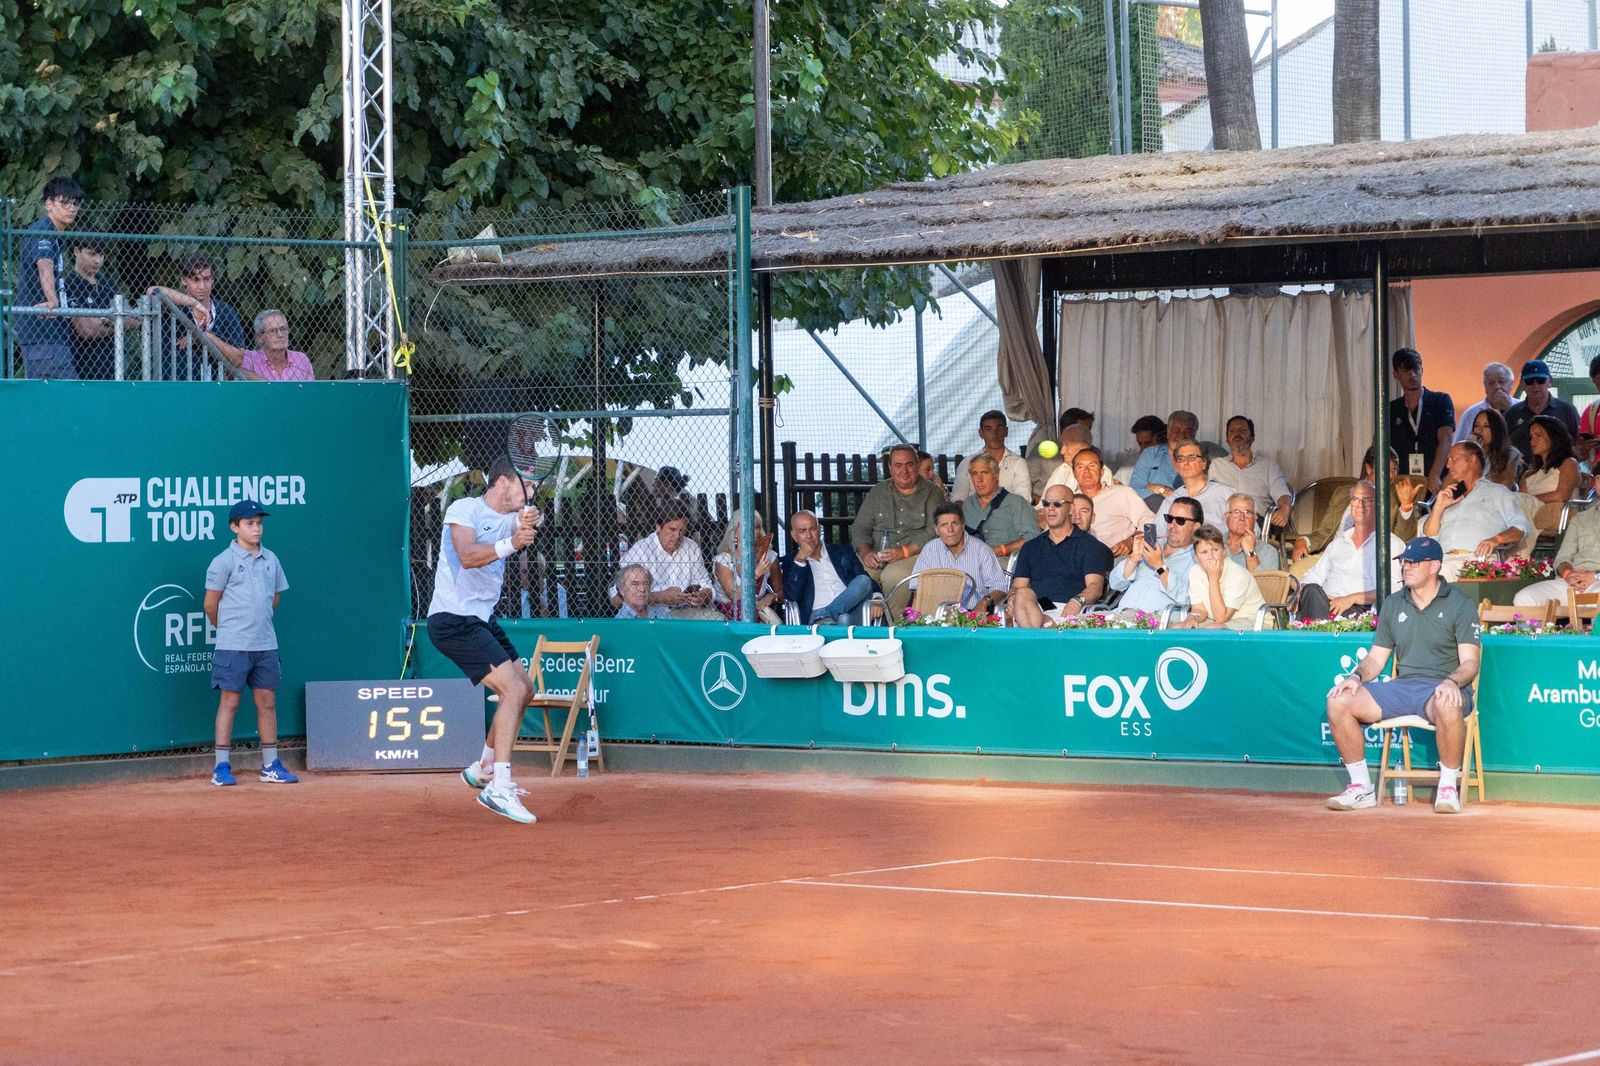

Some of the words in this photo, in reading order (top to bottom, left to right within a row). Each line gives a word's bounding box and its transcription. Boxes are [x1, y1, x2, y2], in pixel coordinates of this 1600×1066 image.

[113, 493, 138, 504] ATP
[147, 475, 306, 507] CHALLENGER
[147, 510, 215, 543] TOUR
[165, 612, 217, 646] RFE
[165, 653, 185, 663] REAL
[187, 651, 216, 662] FEDER
[594, 653, 636, 674] Benz
[165, 662, 206, 674] ESPAÑOLA
[207, 662, 213, 672] D
[357, 686, 434, 700] SPEED
[1063, 674, 1152, 719] FOX
[368, 706, 446, 741] 155
[1120, 721, 1153, 737] ESS
[1320, 722, 1414, 744] PCISA
[375, 749, 419, 760] KM/H
